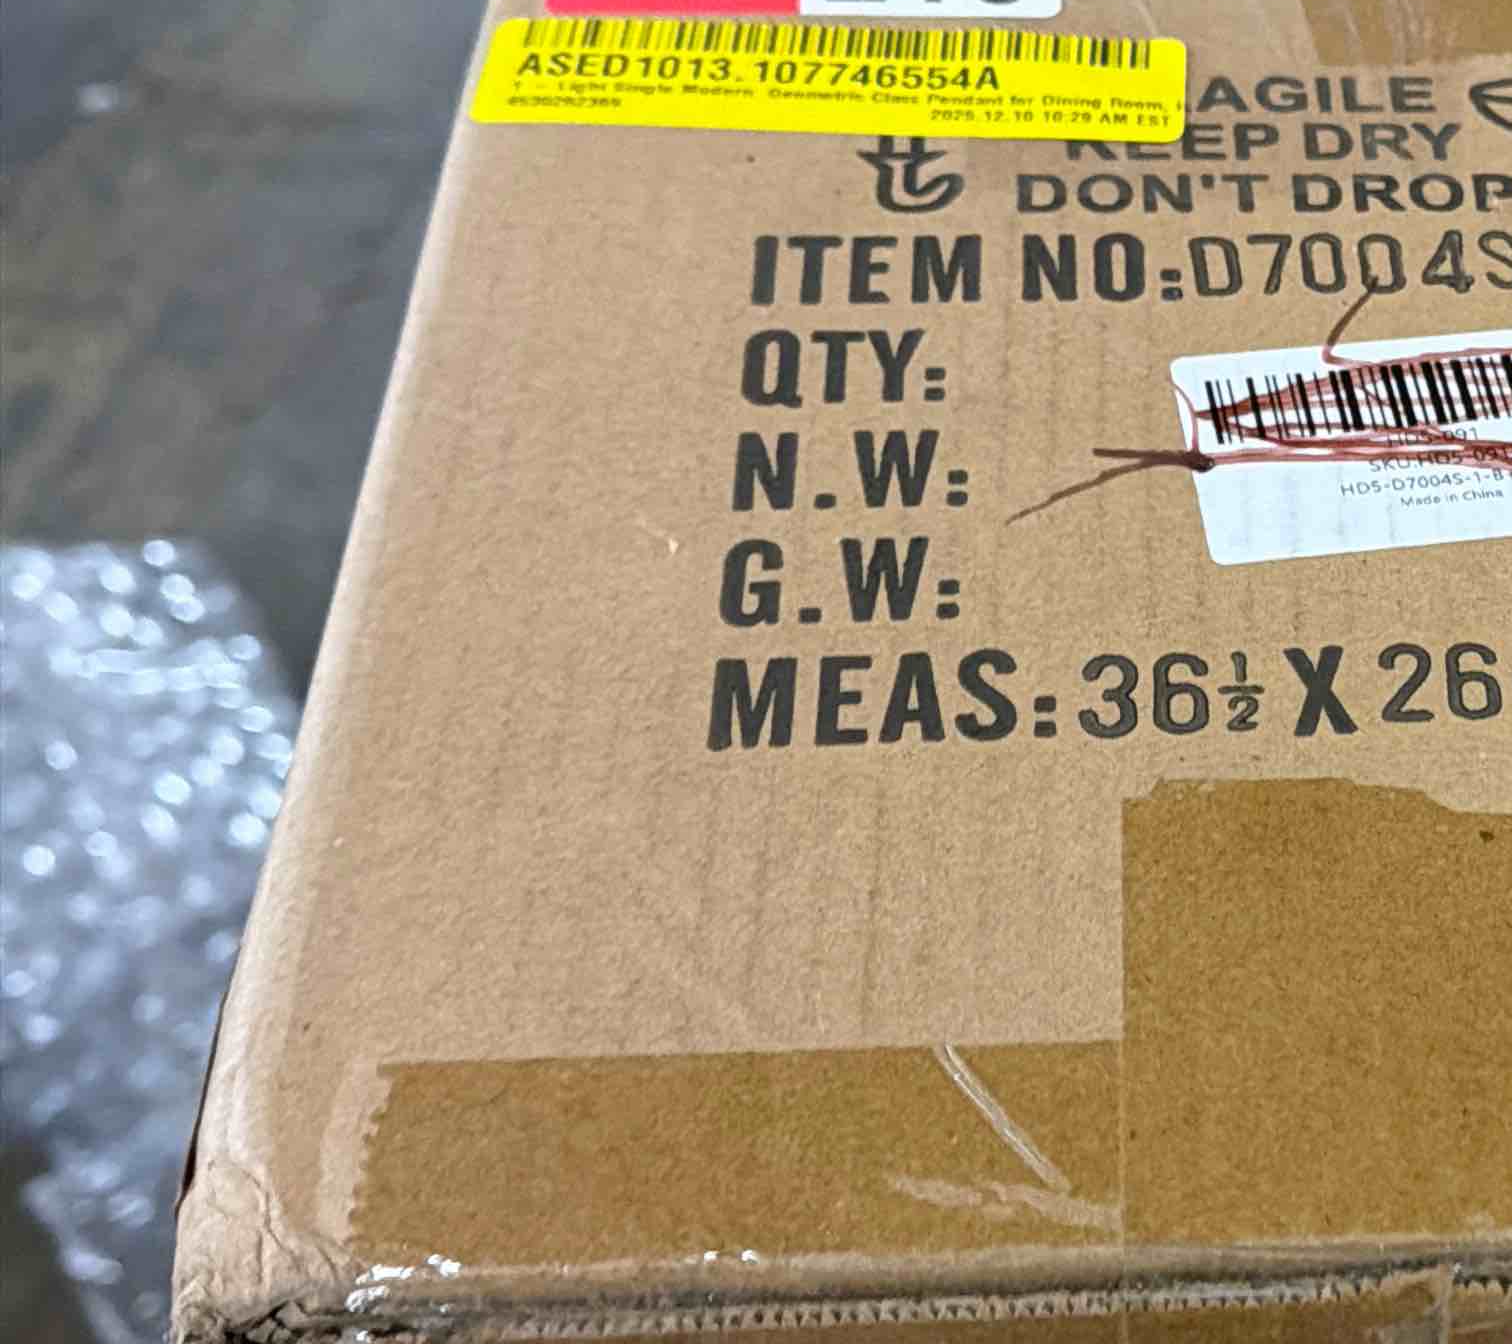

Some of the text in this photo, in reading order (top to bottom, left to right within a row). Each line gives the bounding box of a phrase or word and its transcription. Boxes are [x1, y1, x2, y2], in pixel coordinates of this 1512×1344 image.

[516, 52, 1001, 92] ASED1013.107746554A
[1185, 75, 1437, 114] AGILE
[1099, 112, 1128, 125] AM
[1302, 121, 1461, 161] DRY
[1016, 173, 1269, 214] DON'T
[750, 233, 982, 306] ITEM
[741, 327, 946, 409] QTY:
[731, 429, 969, 512] N.W:
[1400, 488, 1504, 508] Made in China
[718, 536, 961, 628] G.W:
